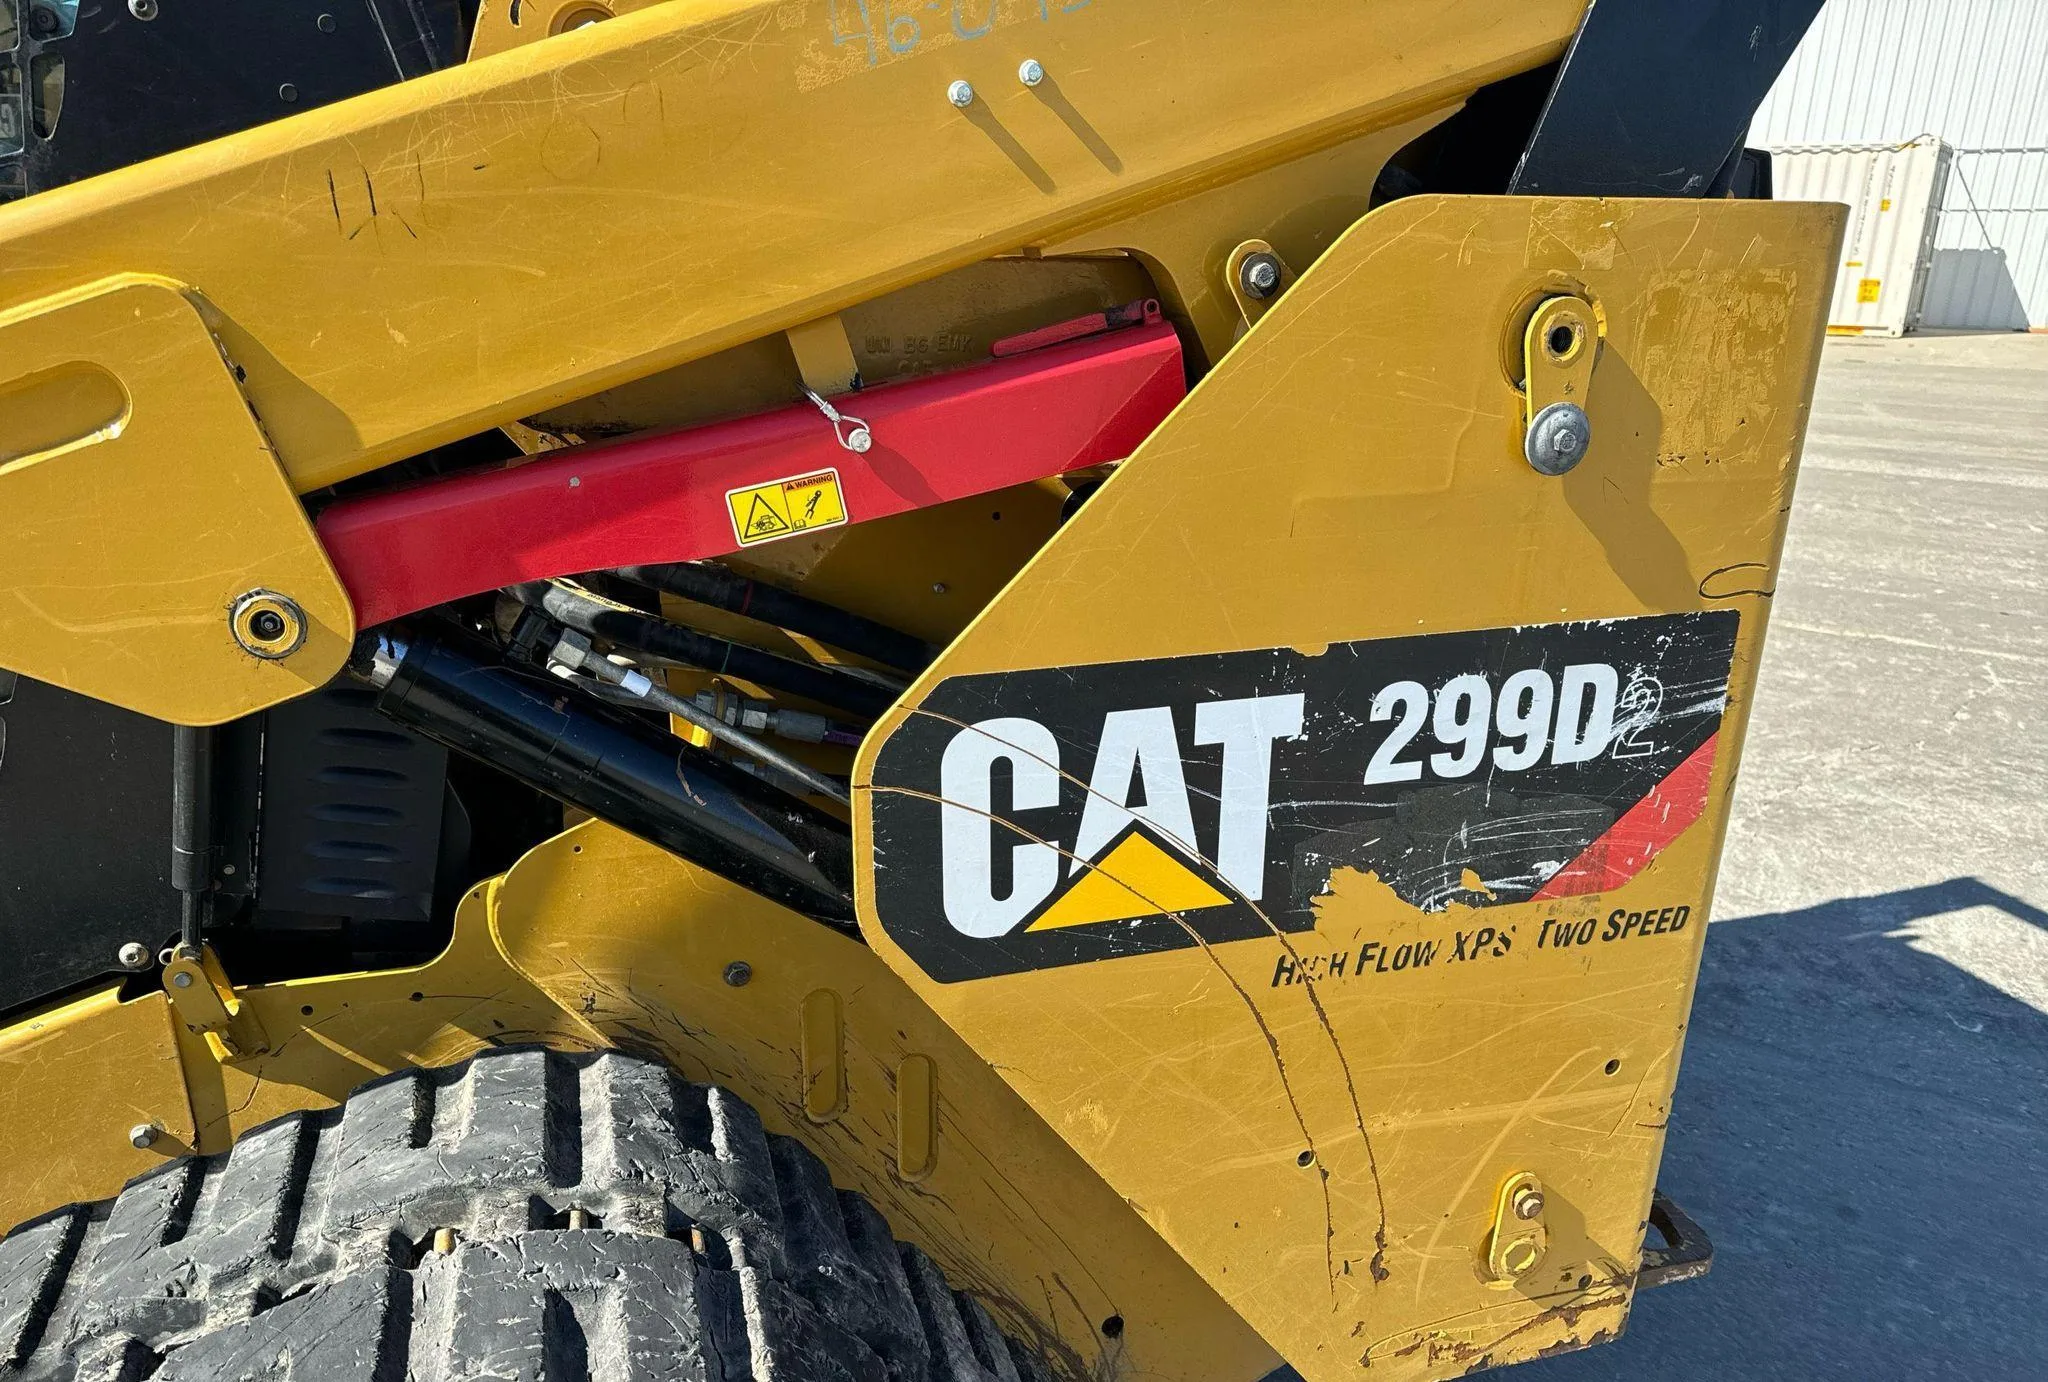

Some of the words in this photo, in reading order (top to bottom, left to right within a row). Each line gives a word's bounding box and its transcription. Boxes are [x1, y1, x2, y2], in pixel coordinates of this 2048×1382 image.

[794, 474, 833, 490] WARNING
[941, 693, 1305, 938] CAT
[1355, 939, 1442, 976] FLOW
[1447, 924, 1516, 964] XPS
[1537, 917, 1597, 949] TWO
[1601, 905, 1690, 942] SPEED
